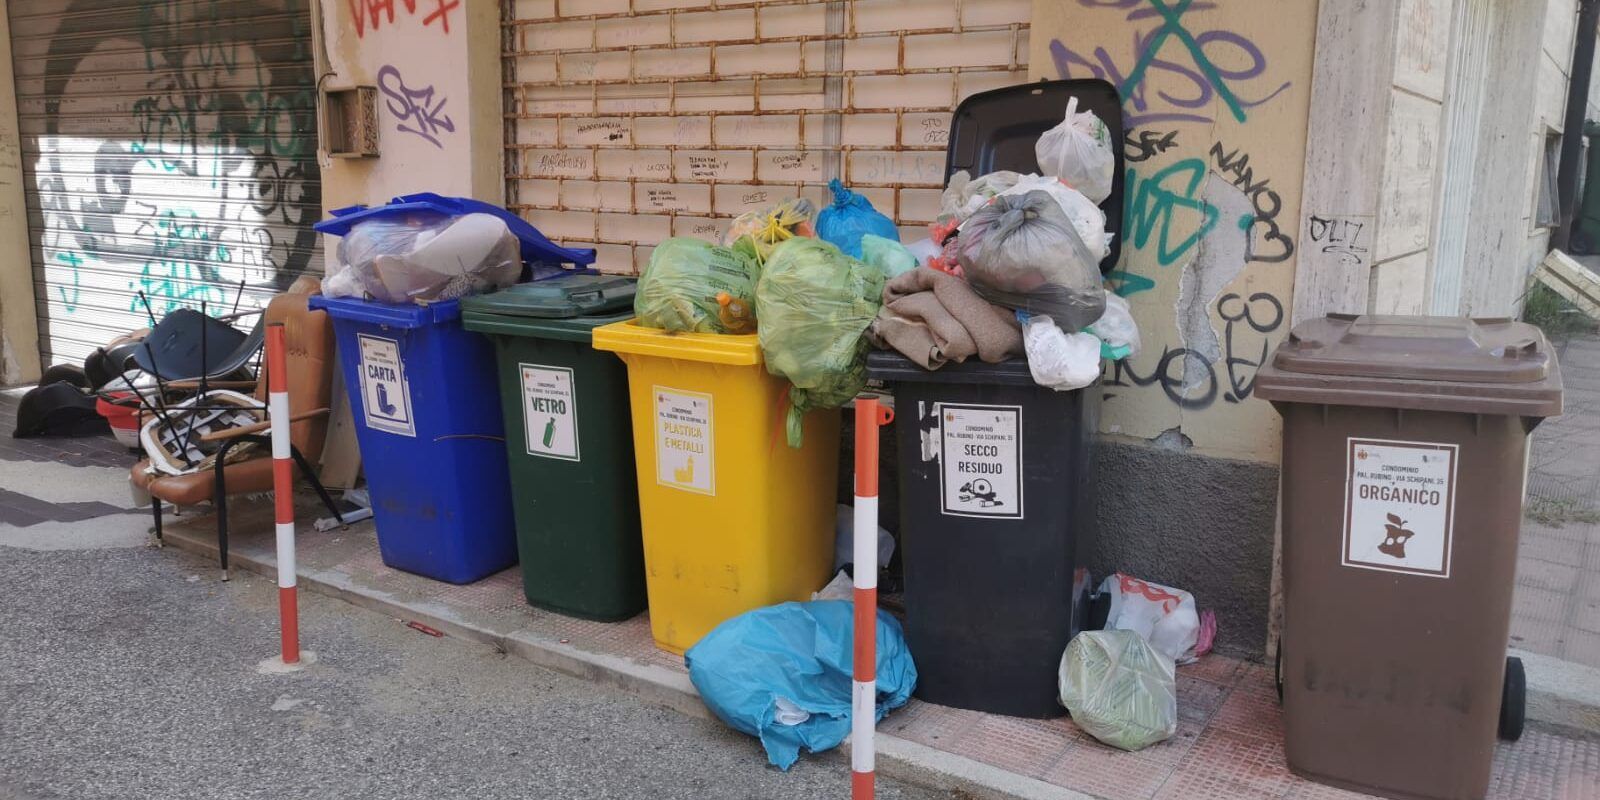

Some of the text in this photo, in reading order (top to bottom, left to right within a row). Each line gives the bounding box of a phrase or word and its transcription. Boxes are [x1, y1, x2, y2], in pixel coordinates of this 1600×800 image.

[368, 364, 397, 383] CARTA
[531, 396, 567, 415] VETRO
[665, 422, 703, 438] PLASTICA
[671, 439, 704, 453] METALLI
[964, 444, 998, 457] SECCO
[958, 461, 1003, 475] RESIDUO
[1381, 465, 1419, 473] CONDOMINIO
[1359, 483, 1440, 506] ORGANICO
